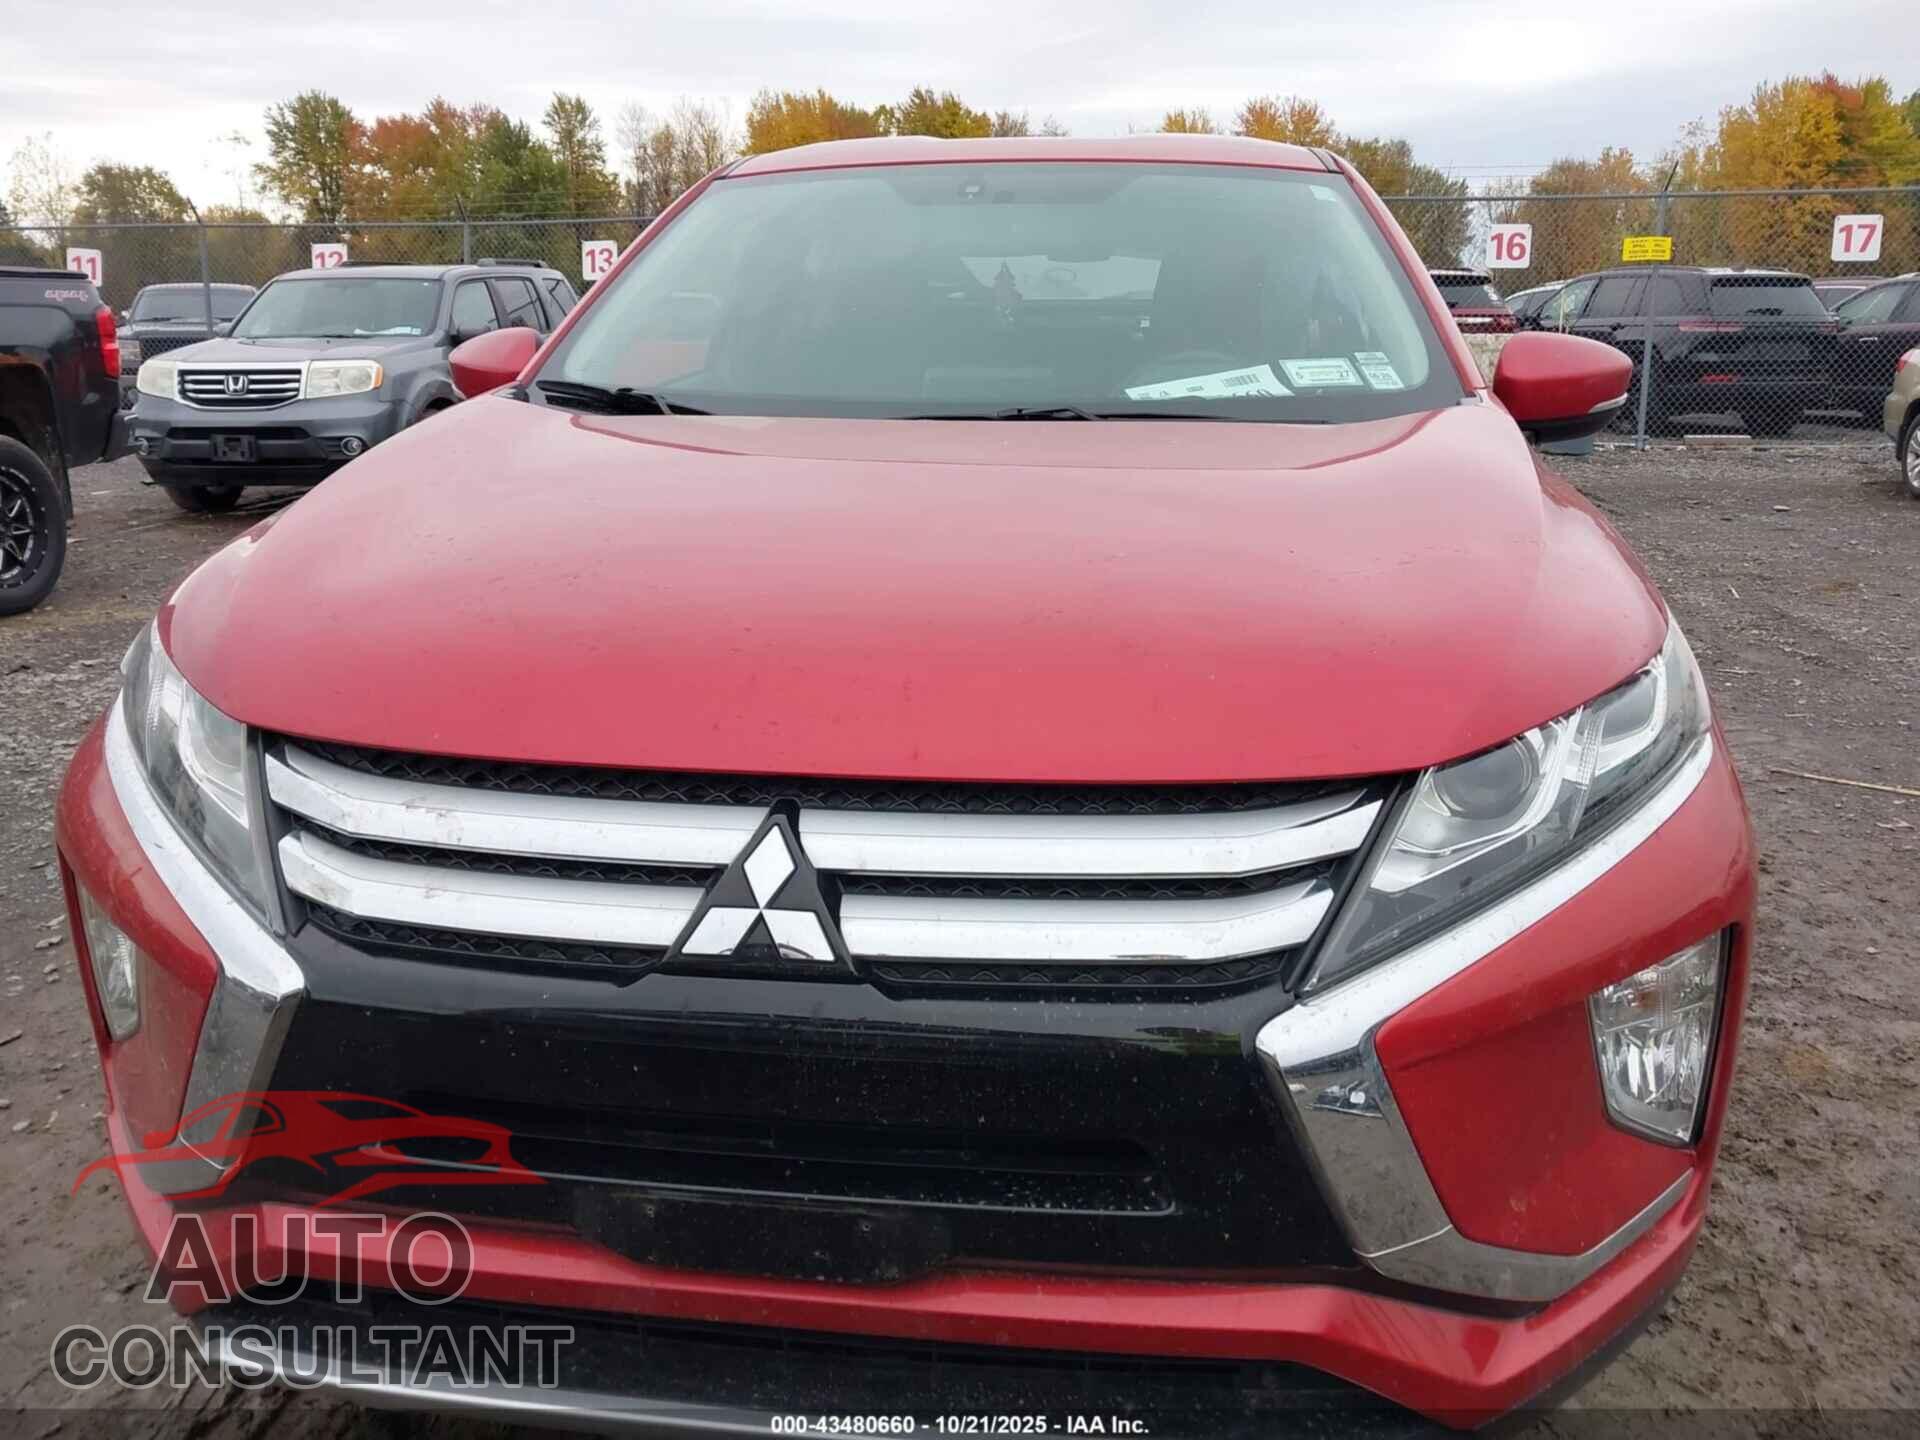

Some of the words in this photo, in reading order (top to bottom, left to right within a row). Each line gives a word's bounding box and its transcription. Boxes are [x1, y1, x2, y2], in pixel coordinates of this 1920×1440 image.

[1491, 232, 1526, 260] 16
[1839, 224, 1877, 252] 17
[71, 256, 97, 281] 11
[315, 251, 343, 268] 12
[585, 248, 613, 273] 13
